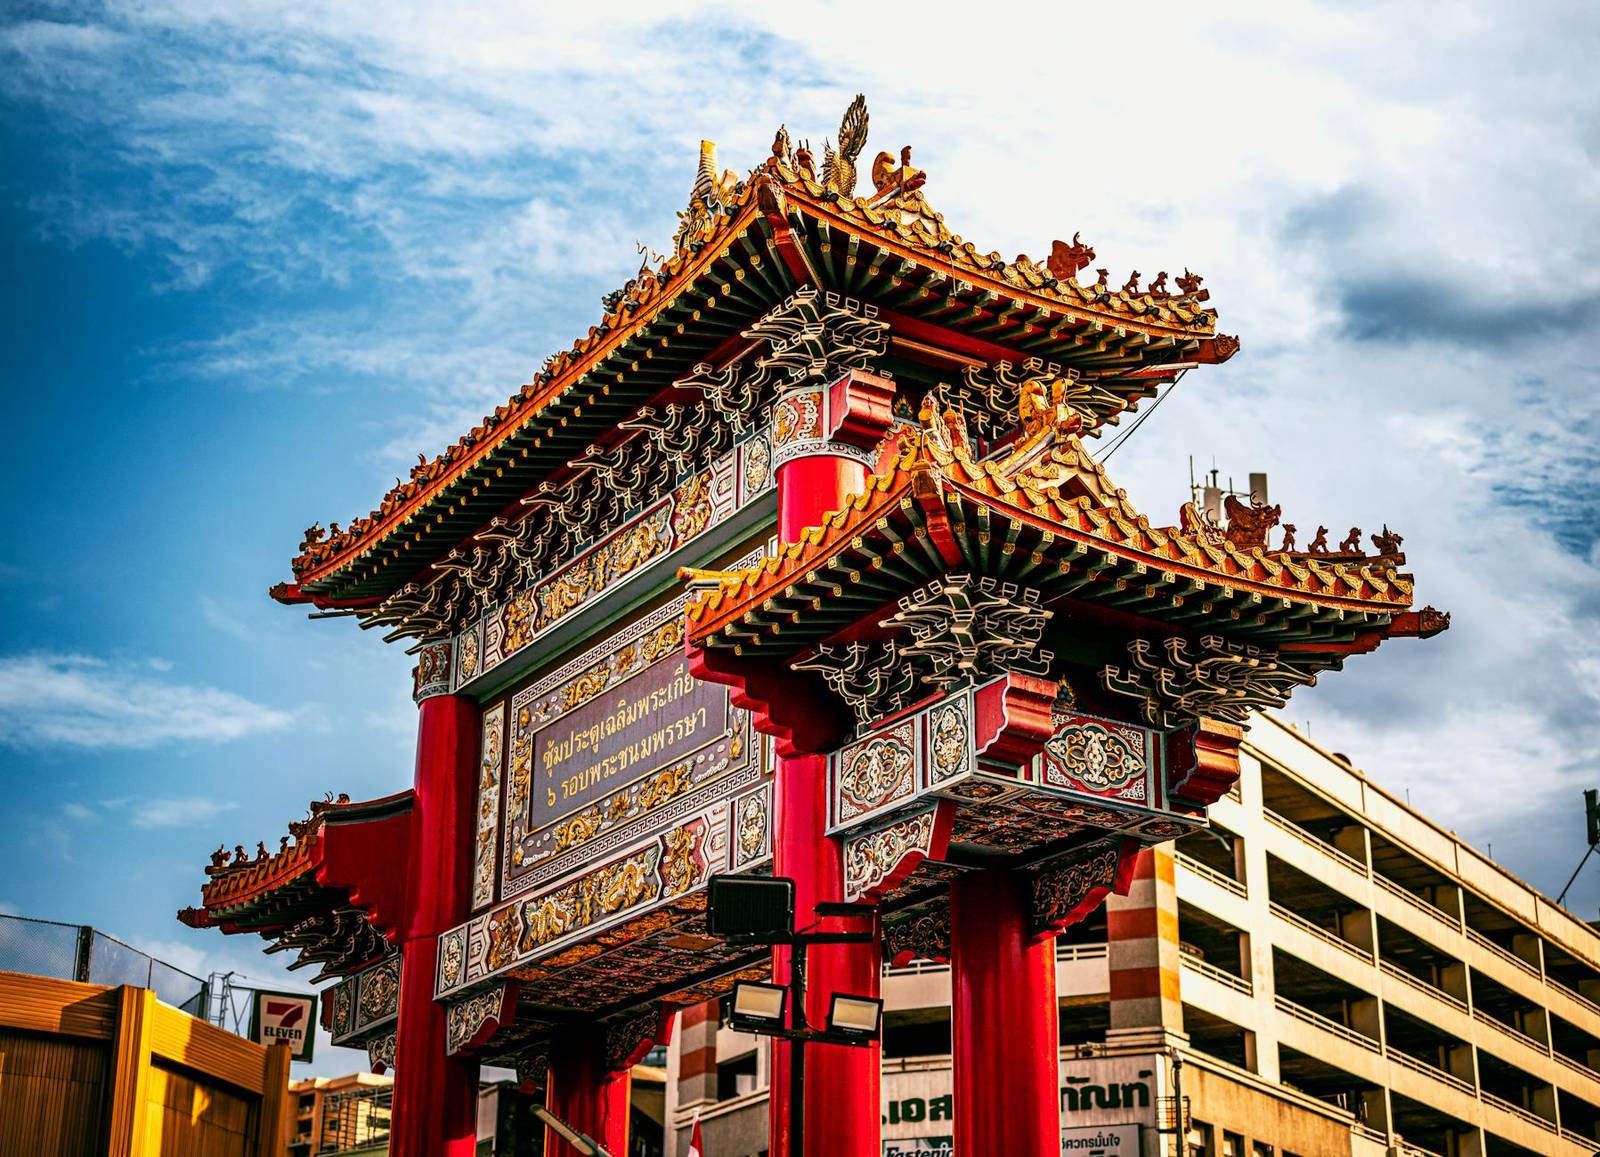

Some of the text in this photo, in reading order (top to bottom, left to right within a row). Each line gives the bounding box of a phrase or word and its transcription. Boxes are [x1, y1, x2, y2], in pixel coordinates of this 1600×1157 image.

[547, 707, 706, 807] ๖ รอบพระชนมพรรษา
[266, 1002, 303, 1046] 7
